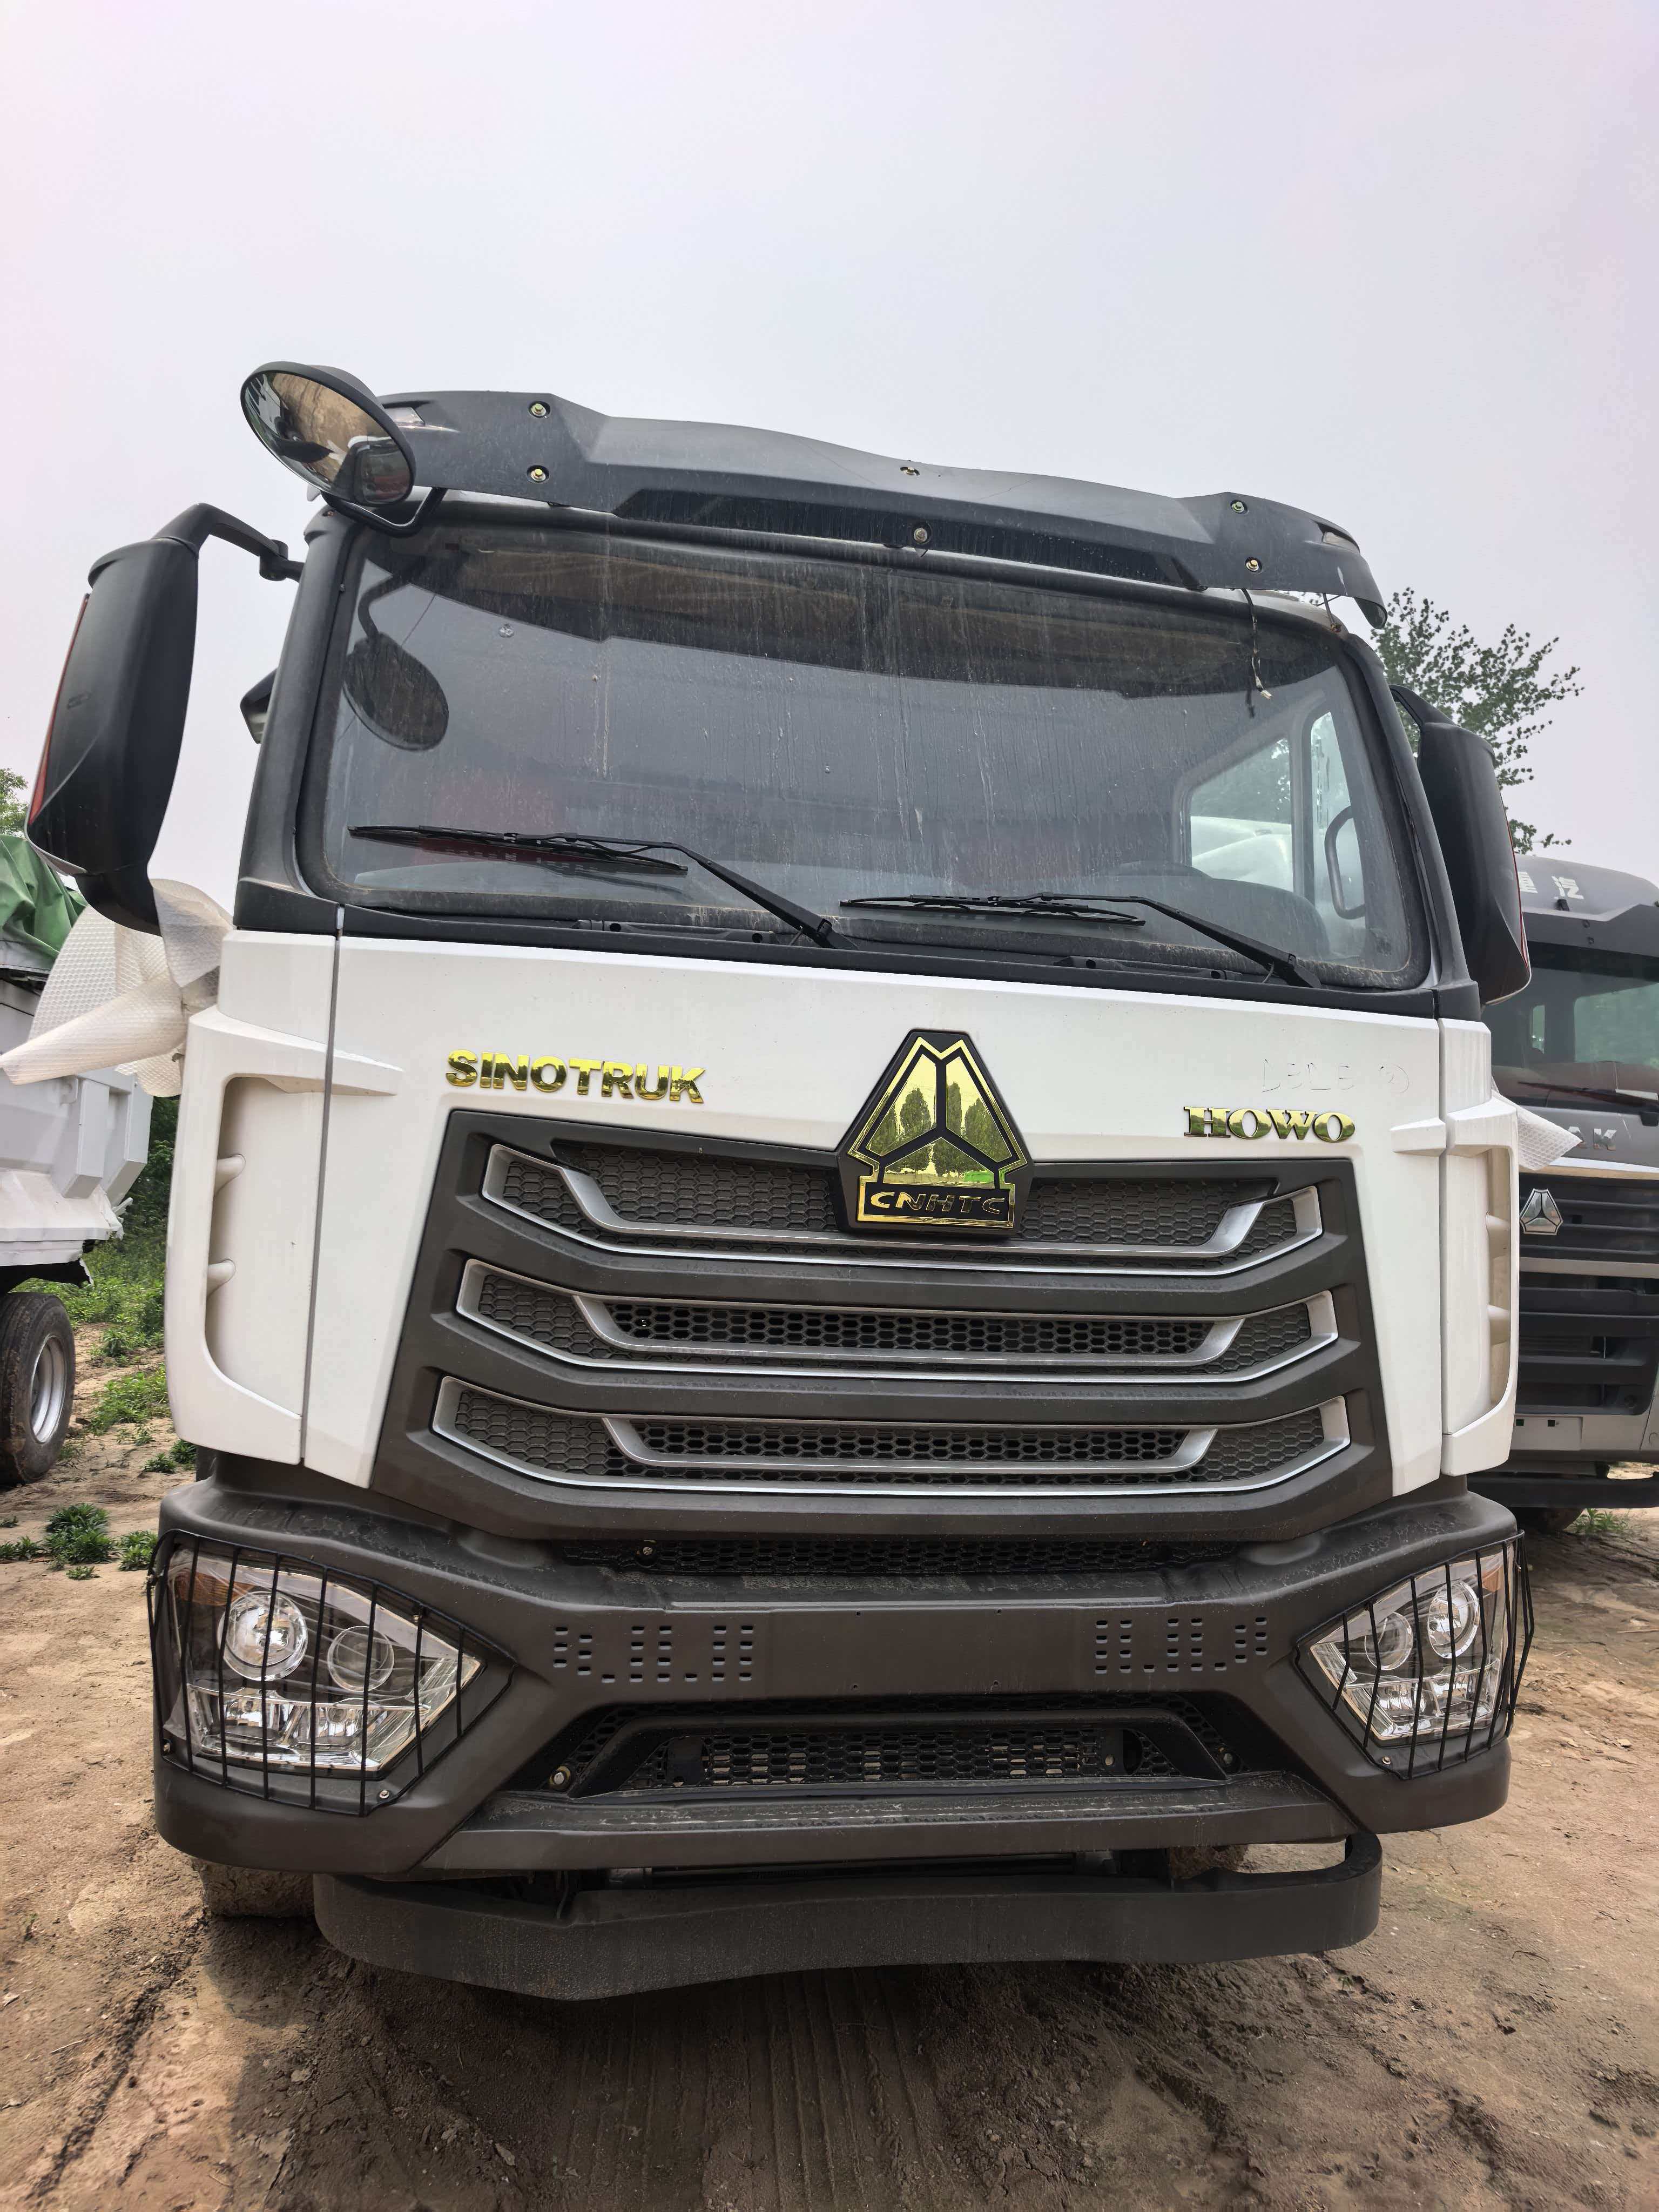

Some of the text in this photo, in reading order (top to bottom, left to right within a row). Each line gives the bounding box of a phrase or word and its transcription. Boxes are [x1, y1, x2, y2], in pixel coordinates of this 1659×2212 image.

[446, 1049, 706, 1103] SINOTRUK
[1183, 1106, 1355, 1143] HOWO
[871, 1191, 1005, 1215] CNHTC
